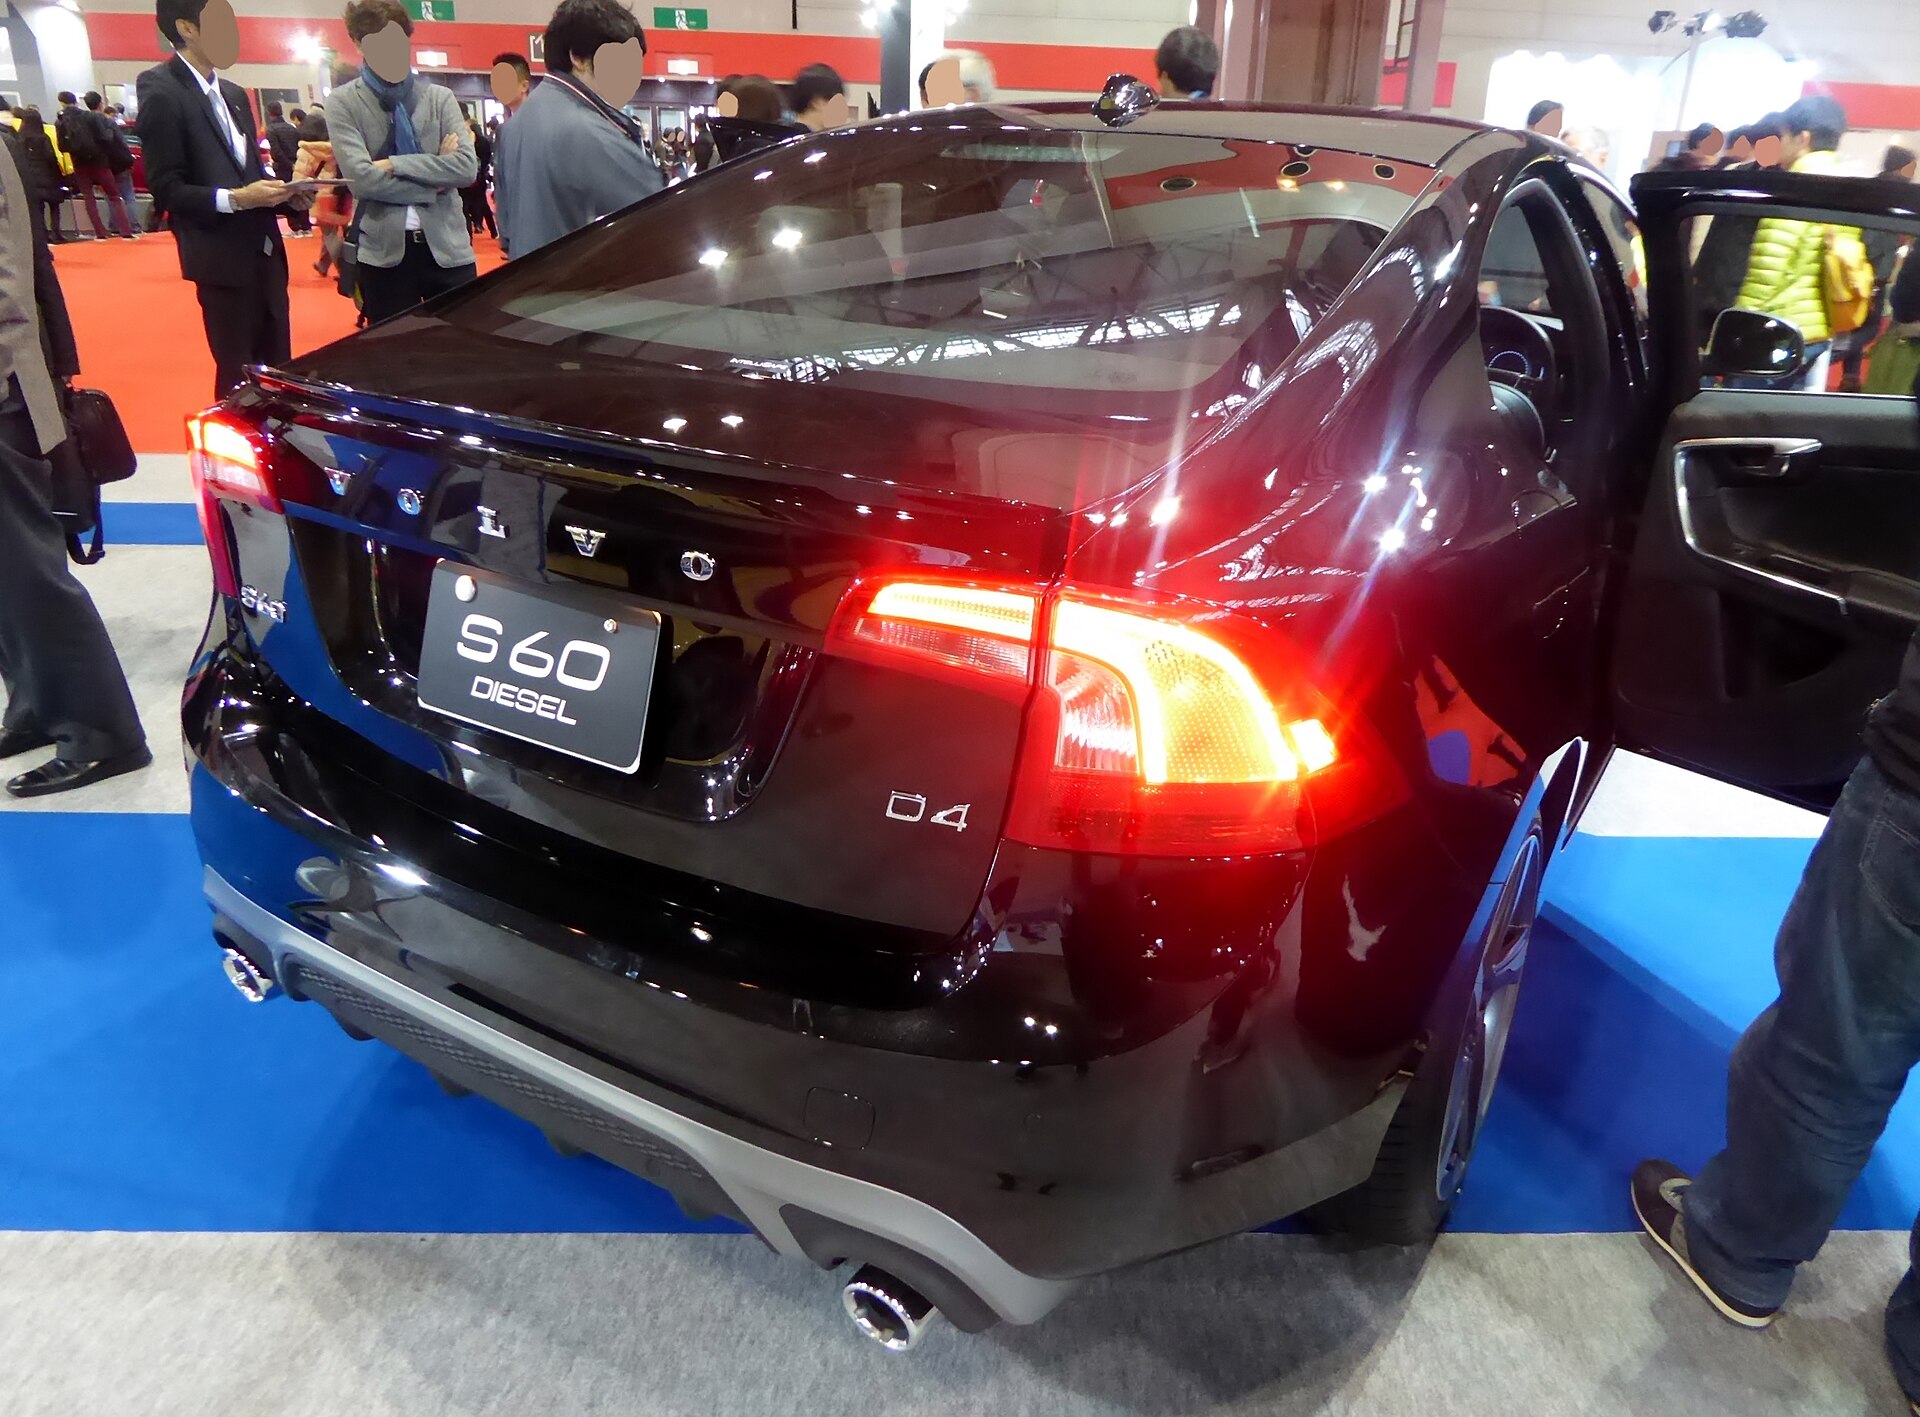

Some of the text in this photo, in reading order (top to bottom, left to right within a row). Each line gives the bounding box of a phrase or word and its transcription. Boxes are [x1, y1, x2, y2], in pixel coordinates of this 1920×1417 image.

[323, 466, 717, 582] VOLVO
[456, 613, 611, 691] S60
[470, 675, 577, 726] DIESEL
[885, 790, 971, 832] D4
